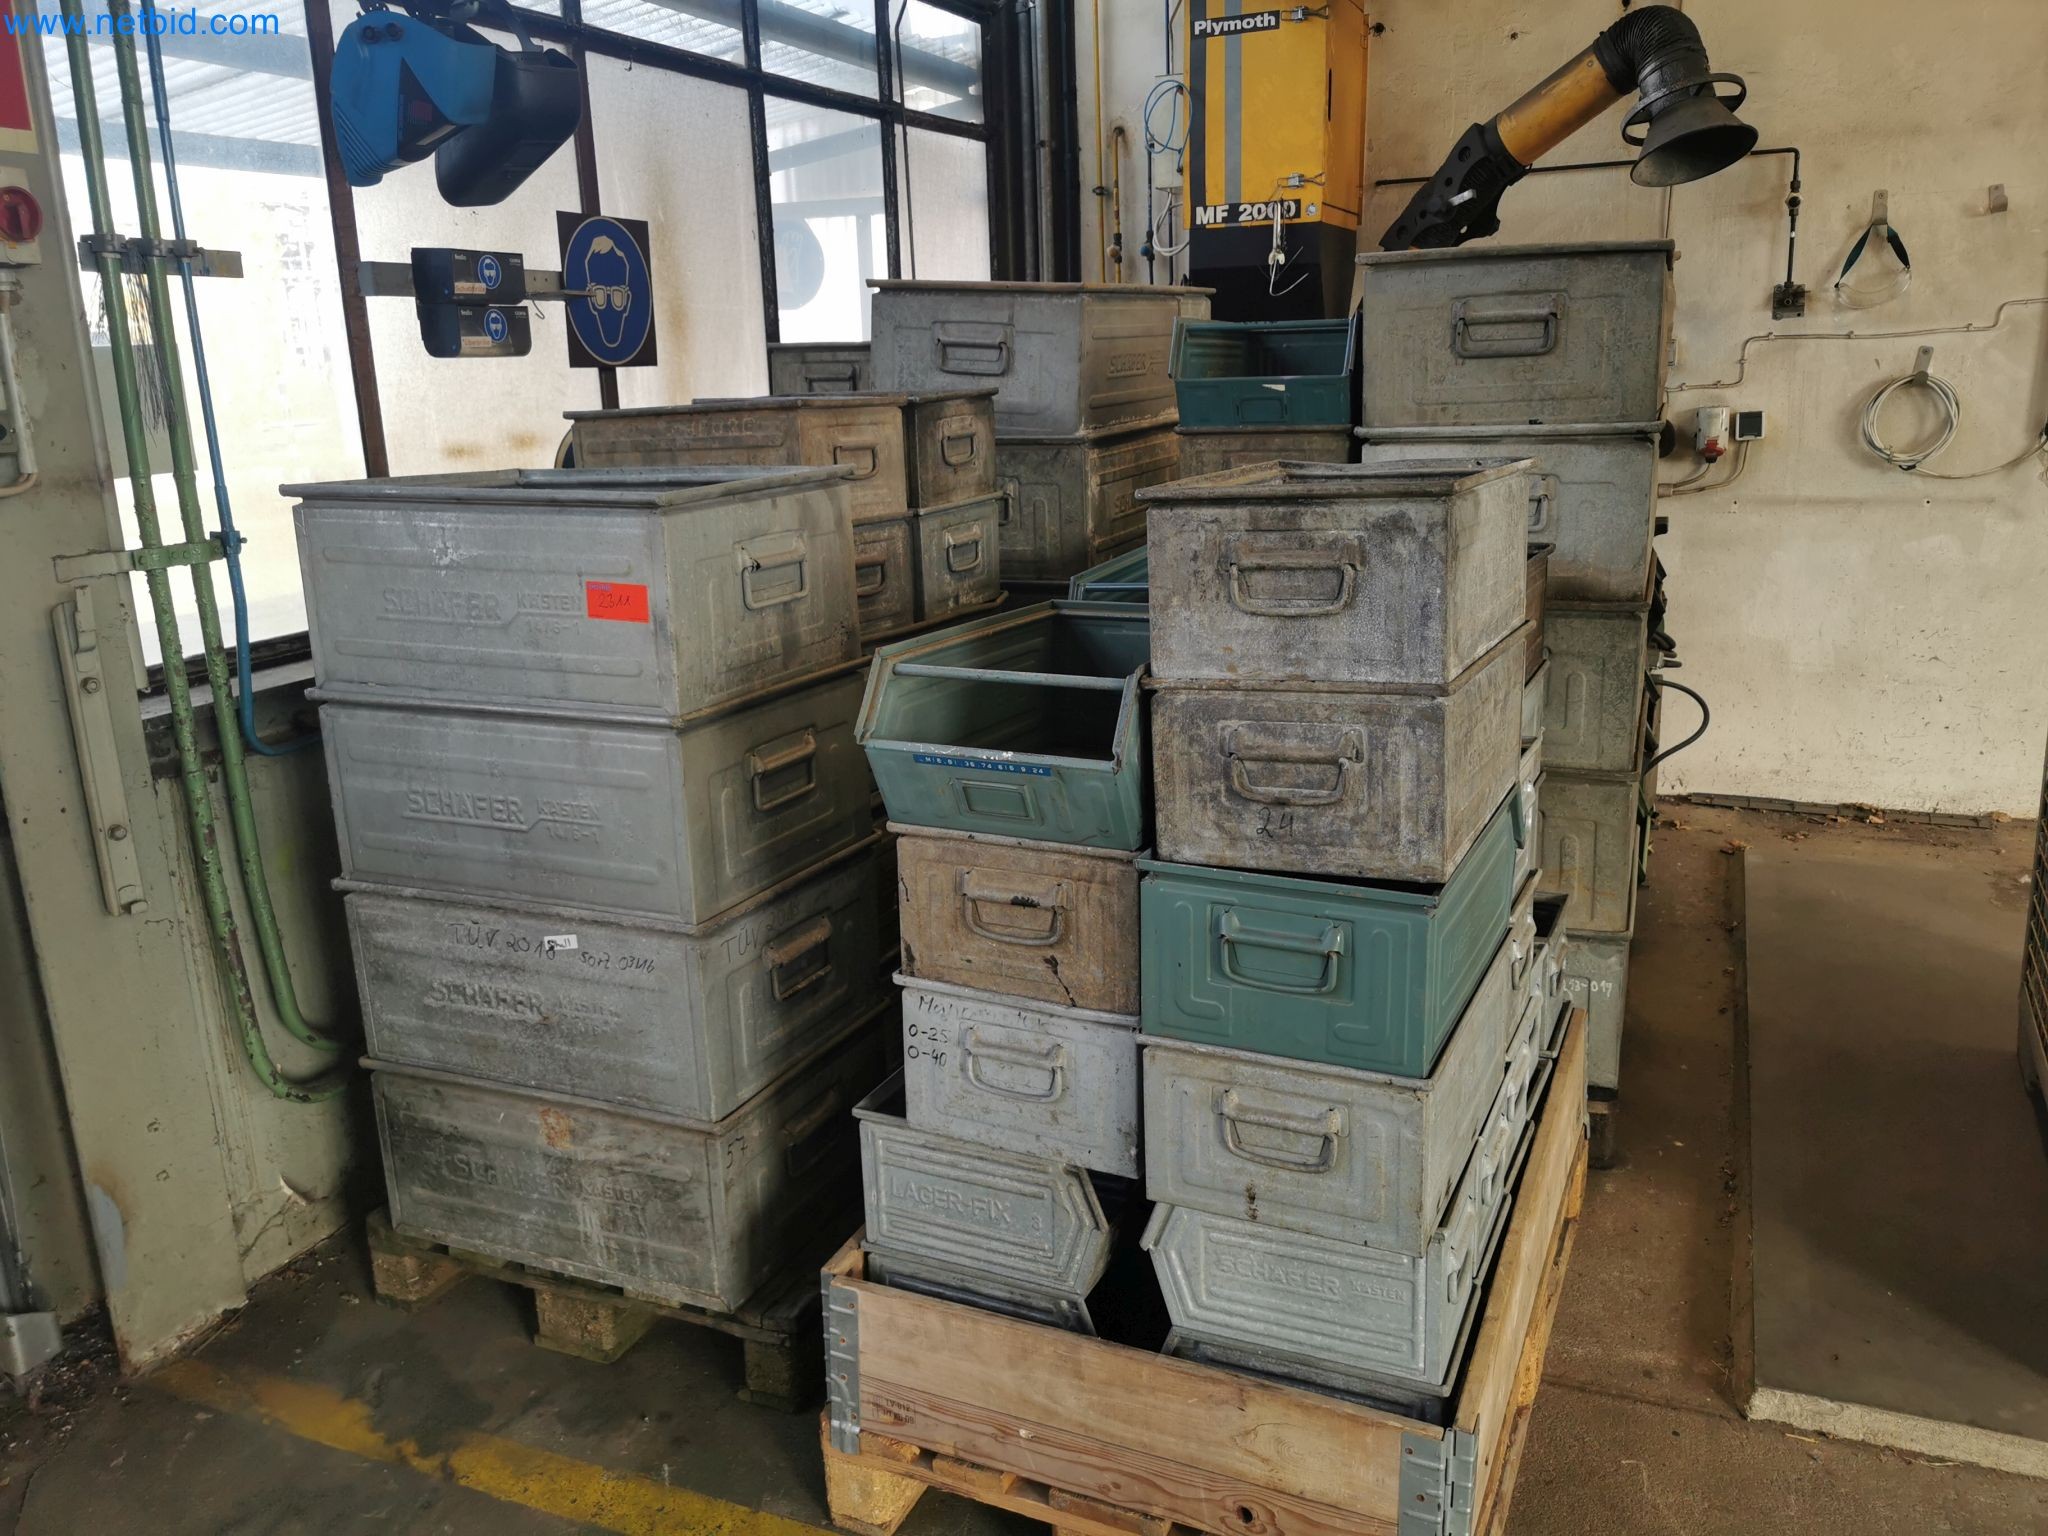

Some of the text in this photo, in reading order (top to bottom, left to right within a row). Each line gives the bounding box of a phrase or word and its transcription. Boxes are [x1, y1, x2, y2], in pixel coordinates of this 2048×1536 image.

[1194, 12, 1276, 36] Plymoth
[1195, 204, 1229, 225] MF
[1255, 806, 1294, 839] 24
[907, 1044, 948, 1068] 0-40
